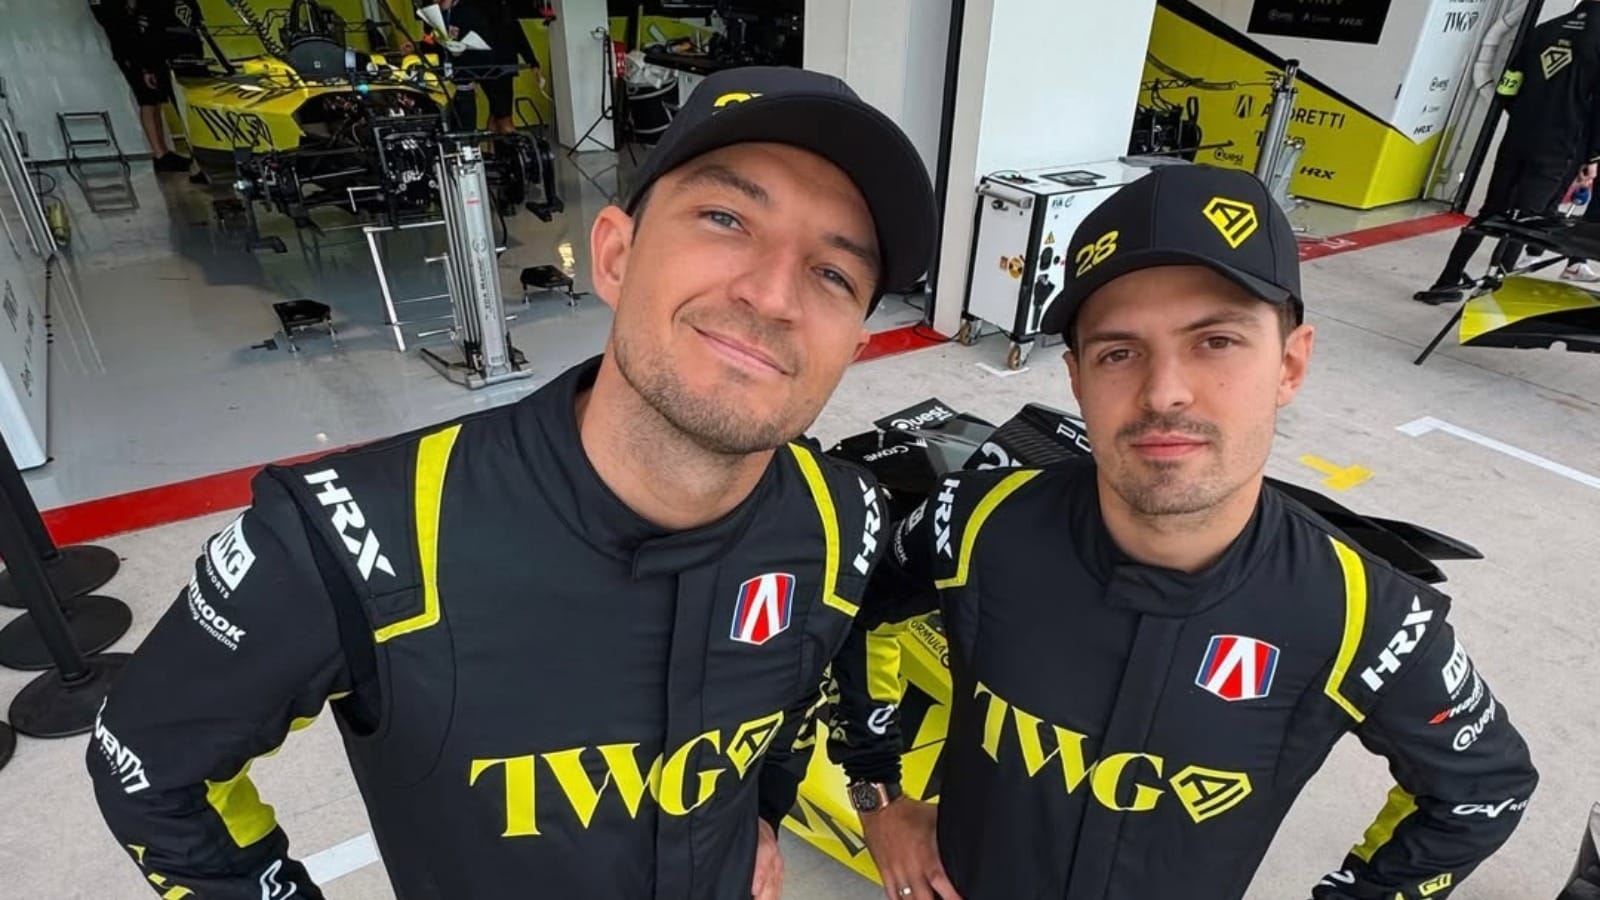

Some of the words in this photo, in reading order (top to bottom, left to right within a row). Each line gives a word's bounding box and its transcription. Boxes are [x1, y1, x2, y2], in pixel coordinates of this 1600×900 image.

[1261, 104, 1346, 129] ARETTI
[1300, 166, 1337, 180] HRX
[1075, 230, 1120, 278] 28
[303, 468, 397, 581] HRX
[853, 475, 881, 576] HRX
[934, 478, 961, 559] HRX
[199, 617, 239, 651] emotion
[910, 620, 947, 655] ORMULA
[1360, 594, 1434, 692] HRX
[469, 729, 726, 838] TWG
[973, 680, 1166, 812] TWG
